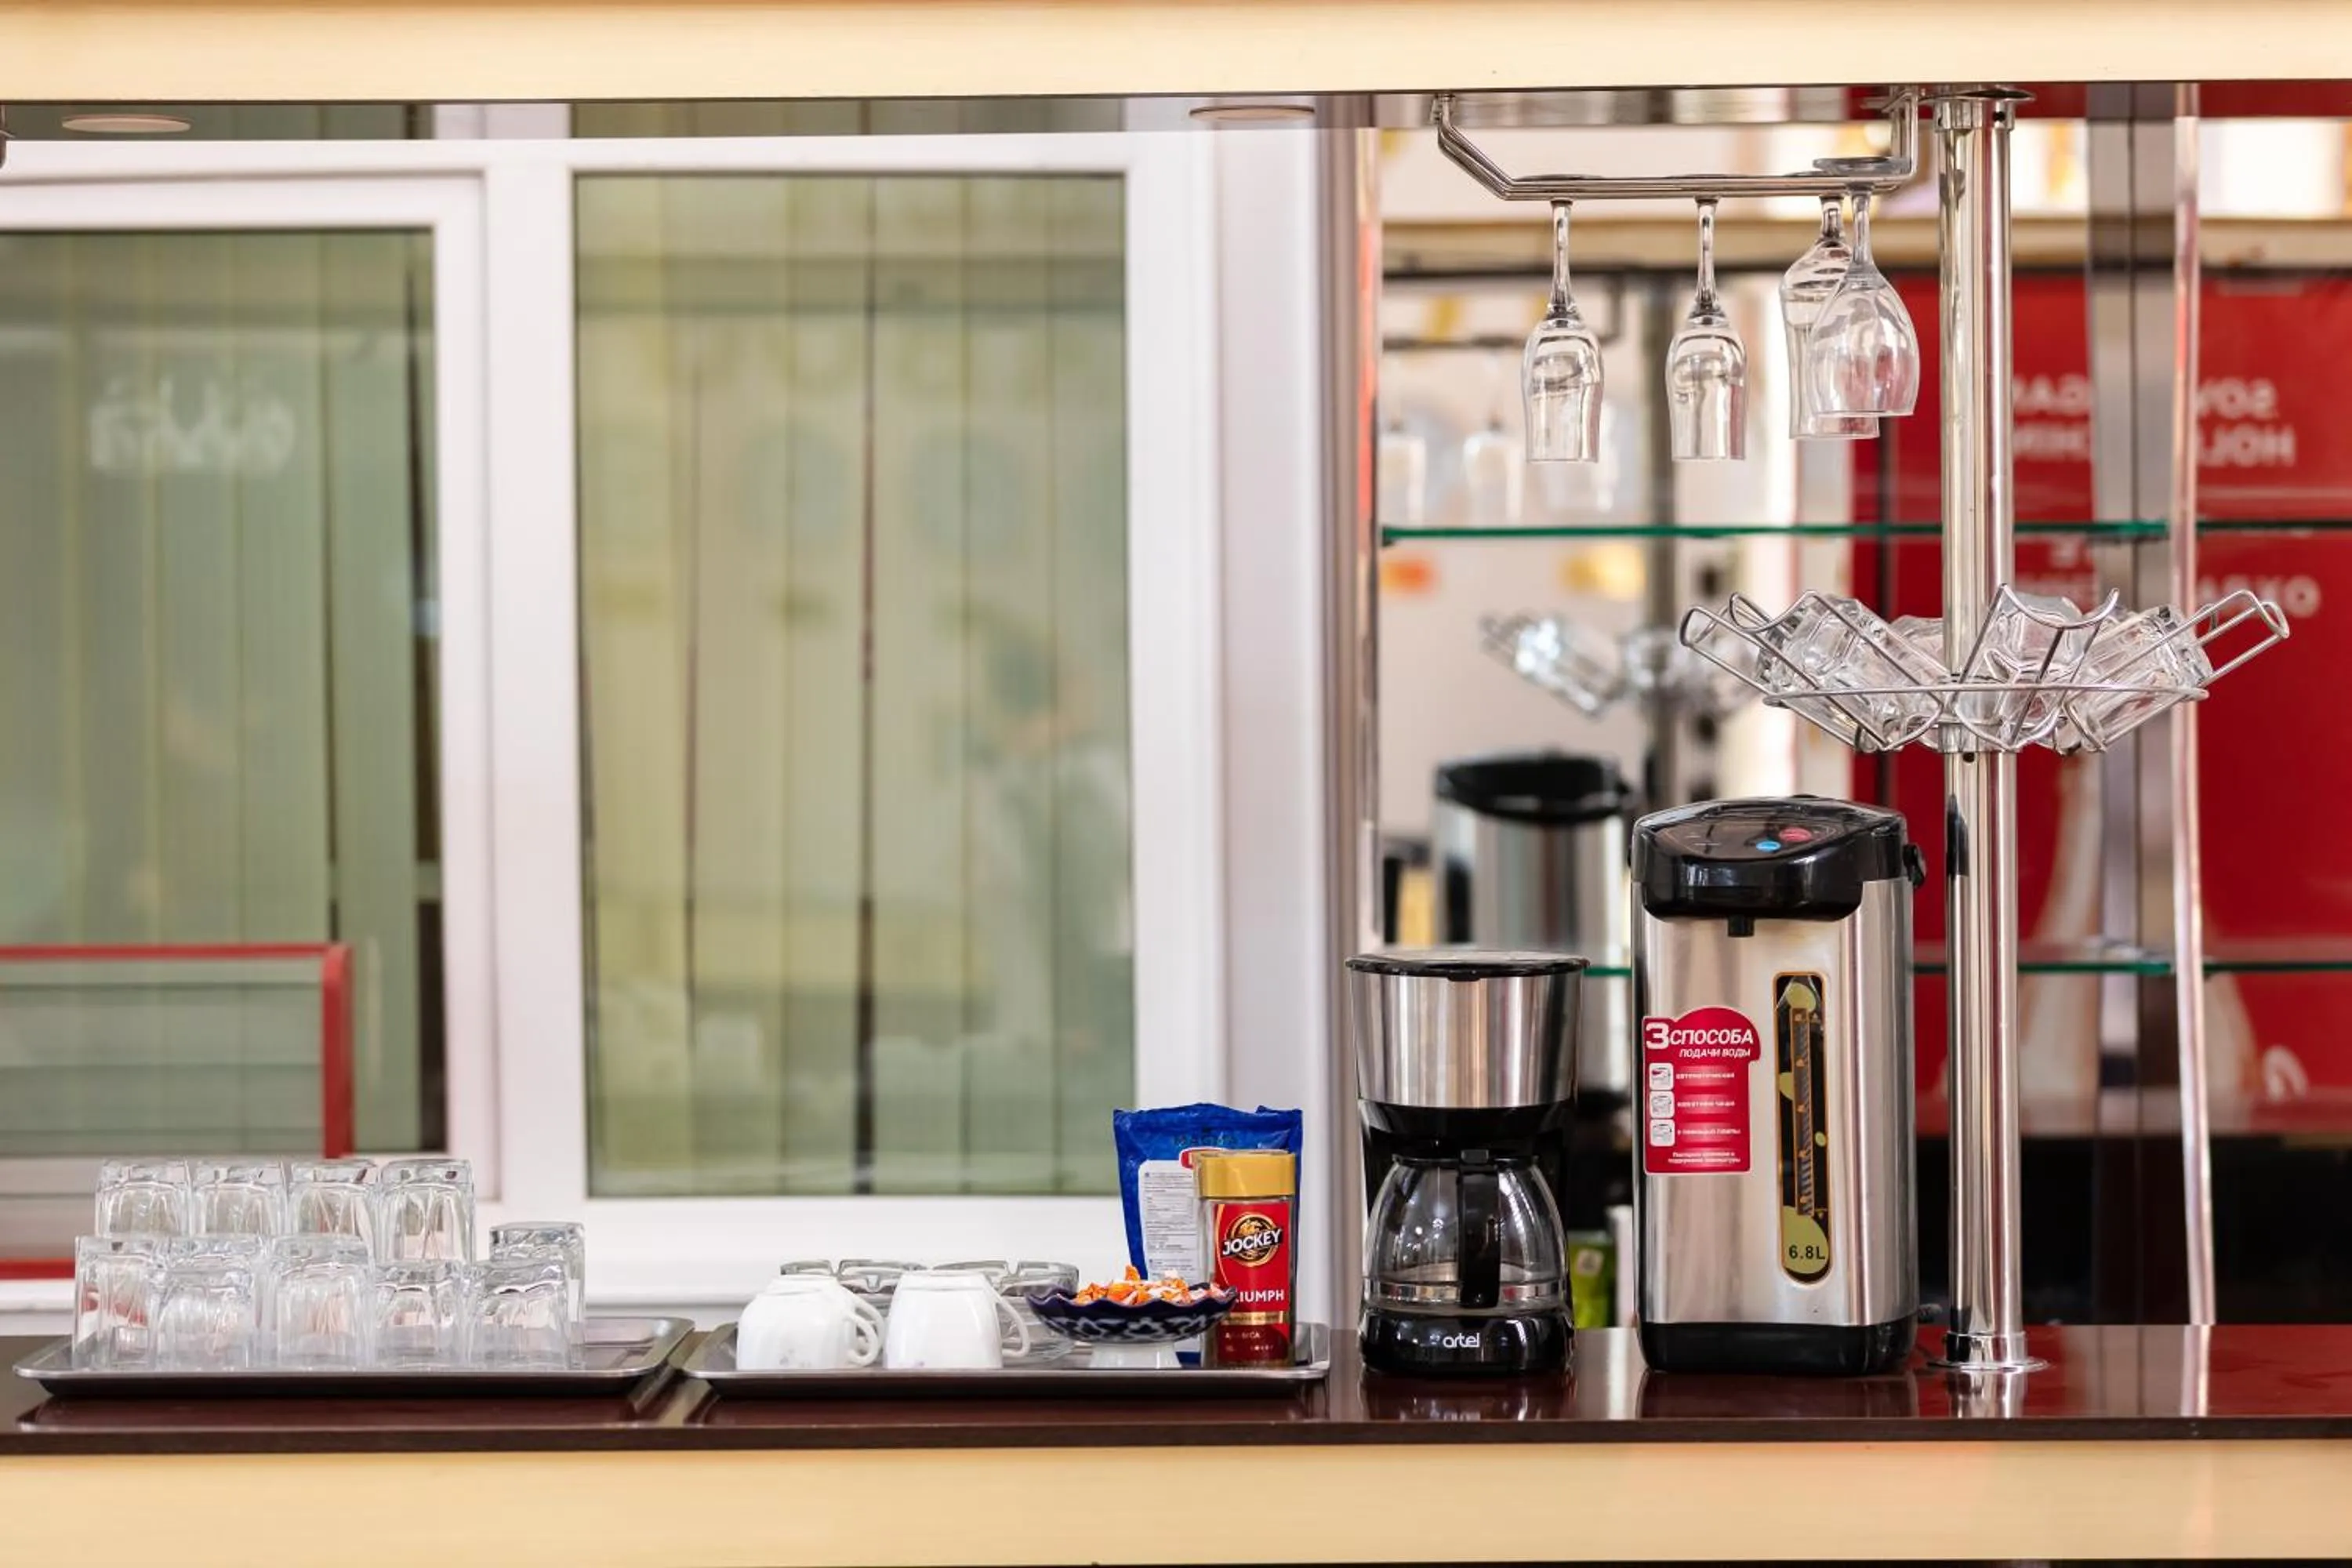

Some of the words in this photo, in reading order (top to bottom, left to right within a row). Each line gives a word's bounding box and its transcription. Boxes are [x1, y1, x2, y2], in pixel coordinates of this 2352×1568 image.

[1646, 1022, 1669, 1050] 3
[1670, 1029, 1754, 1045] СПОСОБА
[1679, 1048, 1721, 1058] ПОДАЧИ
[1721, 1048, 1750, 1058] ВОДЫ
[1222, 1229, 1281, 1255] JOCKEY
[1789, 1245, 1825, 1260] 6.8L
[1235, 1289, 1284, 1303] IUMPH
[1443, 1332, 1479, 1348] artel
